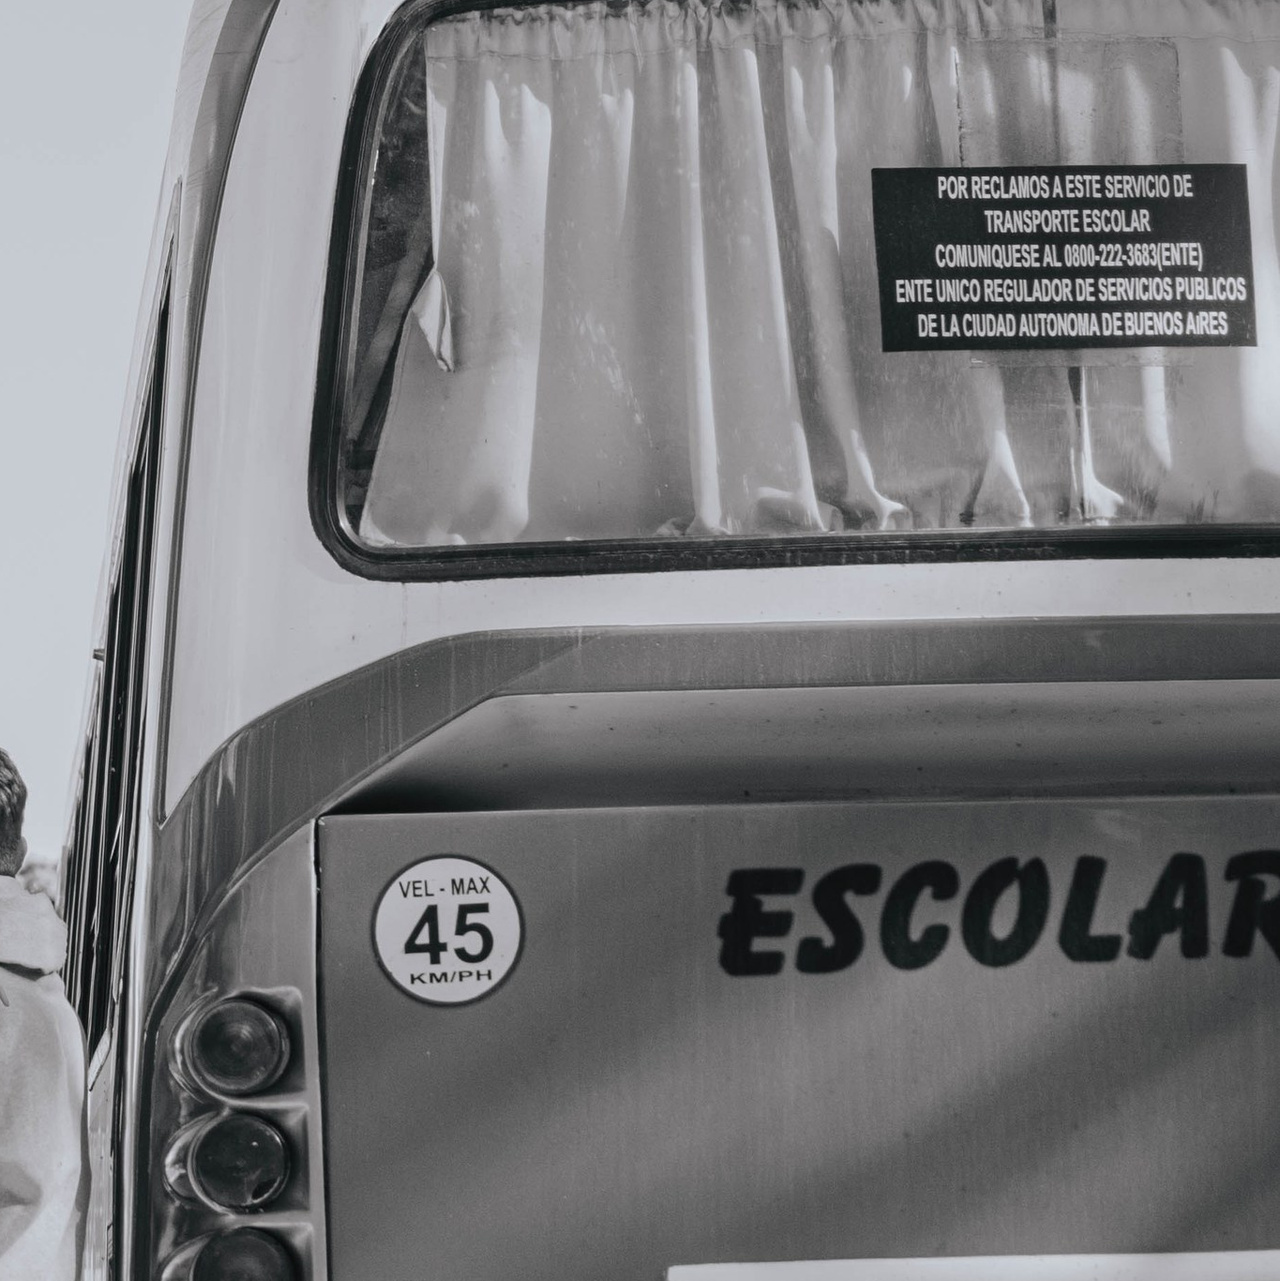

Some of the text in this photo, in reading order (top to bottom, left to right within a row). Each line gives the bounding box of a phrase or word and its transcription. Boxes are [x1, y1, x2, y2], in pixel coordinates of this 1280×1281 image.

[938, 173, 1194, 200] POR RECLAMOS A ESTE SERVICIO DE
[983, 208, 1152, 233] TRANSPORTE ESCOLAR
[935, 243, 1041, 269] COMUNIQUESE
[1042, 244, 1063, 267] AL
[895, 276, 1247, 303] ENTE UNICO REGULADOR DE SERVICIOS PUBLICOS
[918, 313, 939, 338] DE
[940, 313, 961, 337] LA
[962, 313, 1017, 337] CIUDAD
[1018, 312, 1101, 337] AUTONOMA
[1102, 311, 1123, 337] DE
[1124, 310, 1184, 336] BUENOS
[399, 880, 435, 898] VEL
[451, 876, 491, 895] MAX
[717, 850, 1280, 977] ESCOLAR
[404, 902, 494, 965] 45
[410, 969, 492, 985] KM/PH
